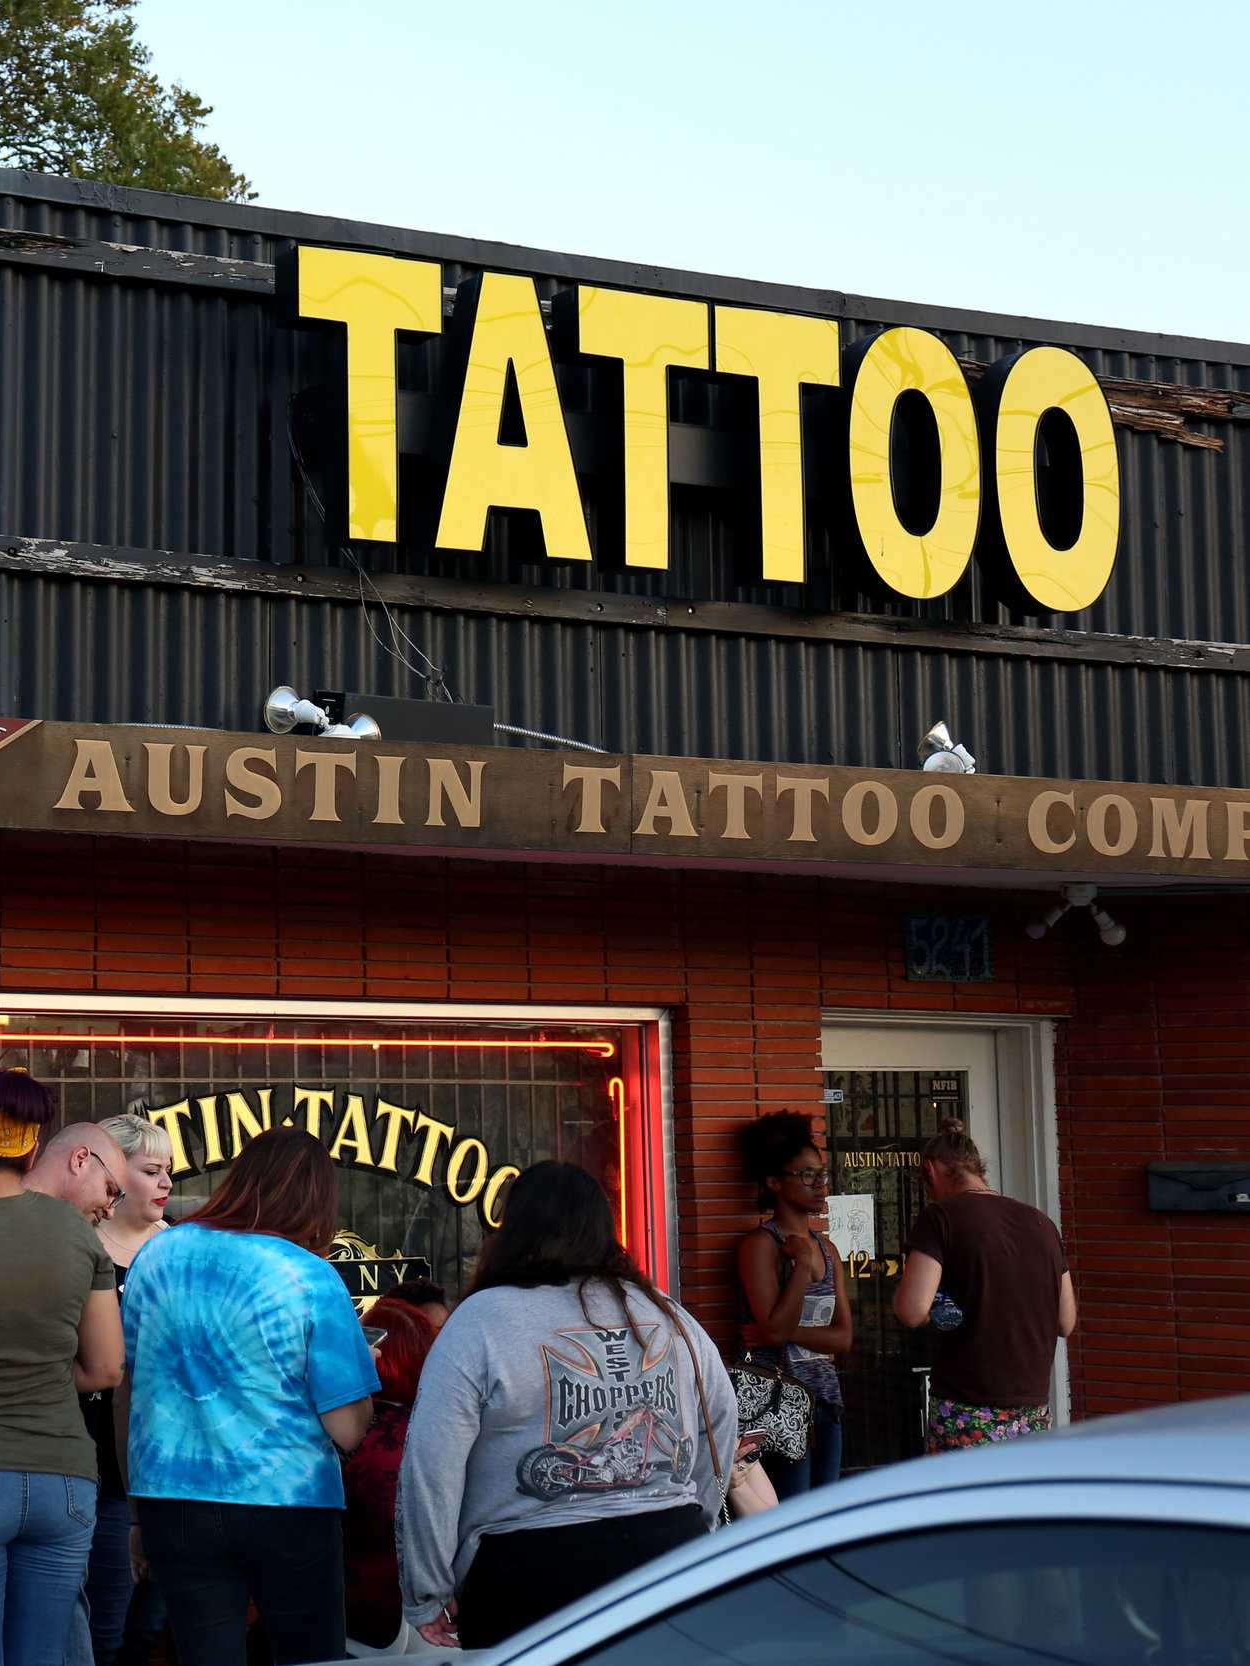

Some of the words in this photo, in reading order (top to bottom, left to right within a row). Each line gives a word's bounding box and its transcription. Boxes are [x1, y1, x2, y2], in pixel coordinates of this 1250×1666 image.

[296, 243, 1121, 613] TATTOO
[52, 738, 488, 829] AUSTIN
[561, 759, 966, 850] TATTOO
[147, 1088, 275, 1173] TIN
[844, 1151, 884, 1168] AUSTIN
[885, 1151, 923, 1168] TATTO
[849, 1249, 871, 1278] 12
[594, 1328, 631, 1383] WEST
[557, 1365, 678, 1429] CHOPPERS
